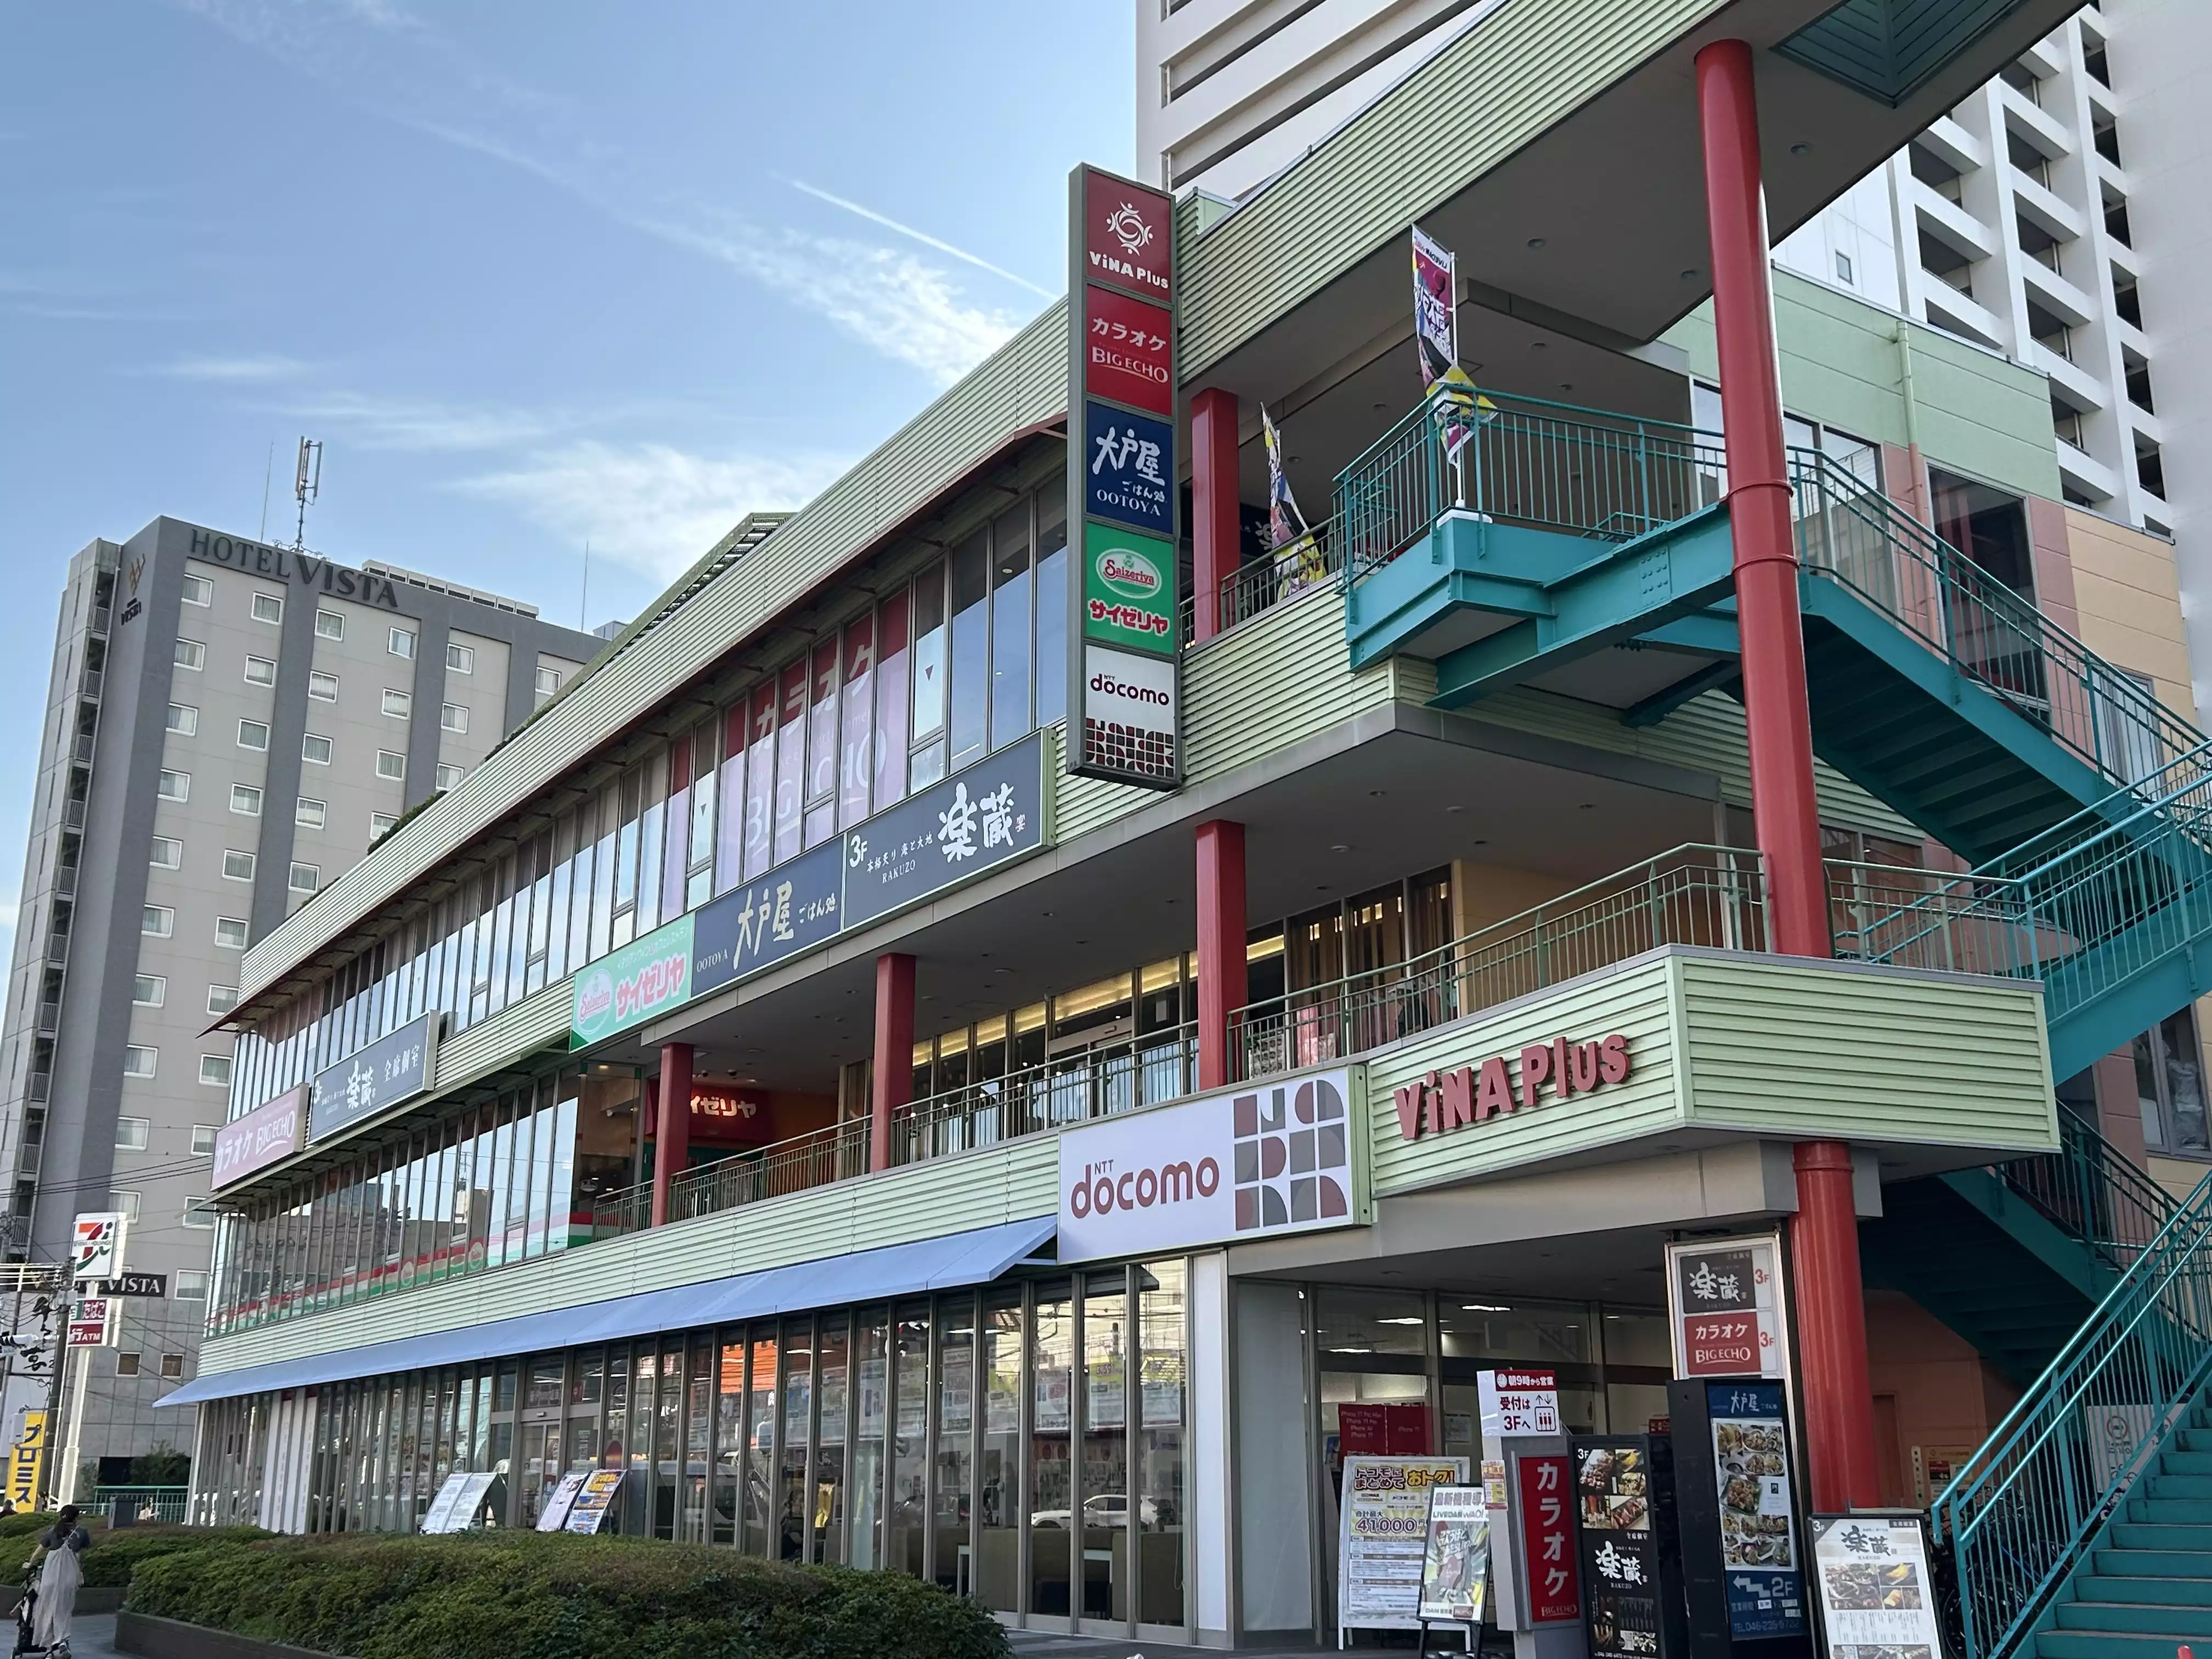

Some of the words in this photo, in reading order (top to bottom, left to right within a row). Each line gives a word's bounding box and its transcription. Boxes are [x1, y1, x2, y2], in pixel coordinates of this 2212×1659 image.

[1136, 267, 1169, 289] Plus
[1091, 317, 1167, 351] カラオケ
[1092, 346, 1122, 366] BIG
[1125, 358, 1169, 383] ECHO
[1092, 426, 1166, 487] 大戸屋
[1097, 489, 1161, 517] OOTOYA
[190, 528, 291, 579] HOTEL
[294, 554, 398, 608] VISTA
[1103, 558, 1155, 586] Saizeriya
[1089, 599, 1169, 635] サイゼリヤ
[1090, 673, 1170, 706] docomo
[937, 782, 1015, 863] 楽蔵
[849, 834, 868, 867] 3F
[882, 859, 916, 884] RAKUZO
[733, 880, 794, 970] 大戸屋
[696, 949, 729, 973] OOTOYA
[616, 953, 686, 1021] サイゼリヤ
[1521, 1034, 1630, 1107] Plus
[213, 1129, 253, 1177] カラオケ
[1094, 1159, 1114, 1173] NTT
[1071, 1156, 1221, 1220] docomo
[108, 1277, 160, 1294] VISTA
[1688, 1261, 1741, 1302] 楽蔵
[1754, 1268, 1770, 1285] 3F
[82, 1300, 106, 1319] たばこ
[1695, 1323, 1748, 1341] カラオケ
[1759, 1331, 1775, 1348] 3F
[1695, 1349, 1717, 1364] BIG
[1718, 1346, 1752, 1362] ECHO
[1500, 1396, 1531, 1411] 受付は
[1730, 1390, 1760, 1414] 大戸屋
[15, 1424, 42, 1504] プロミス
[1577, 1448, 1589, 1460] 3F
[1537, 1462, 1568, 1597] カラオケ
[1813, 1521, 1826, 1532] 3F
[1841, 1525, 1891, 1556] 楽蔵
[1595, 1541, 1643, 1585] 楽蔵
[1771, 1576, 1793, 1598] 2F
